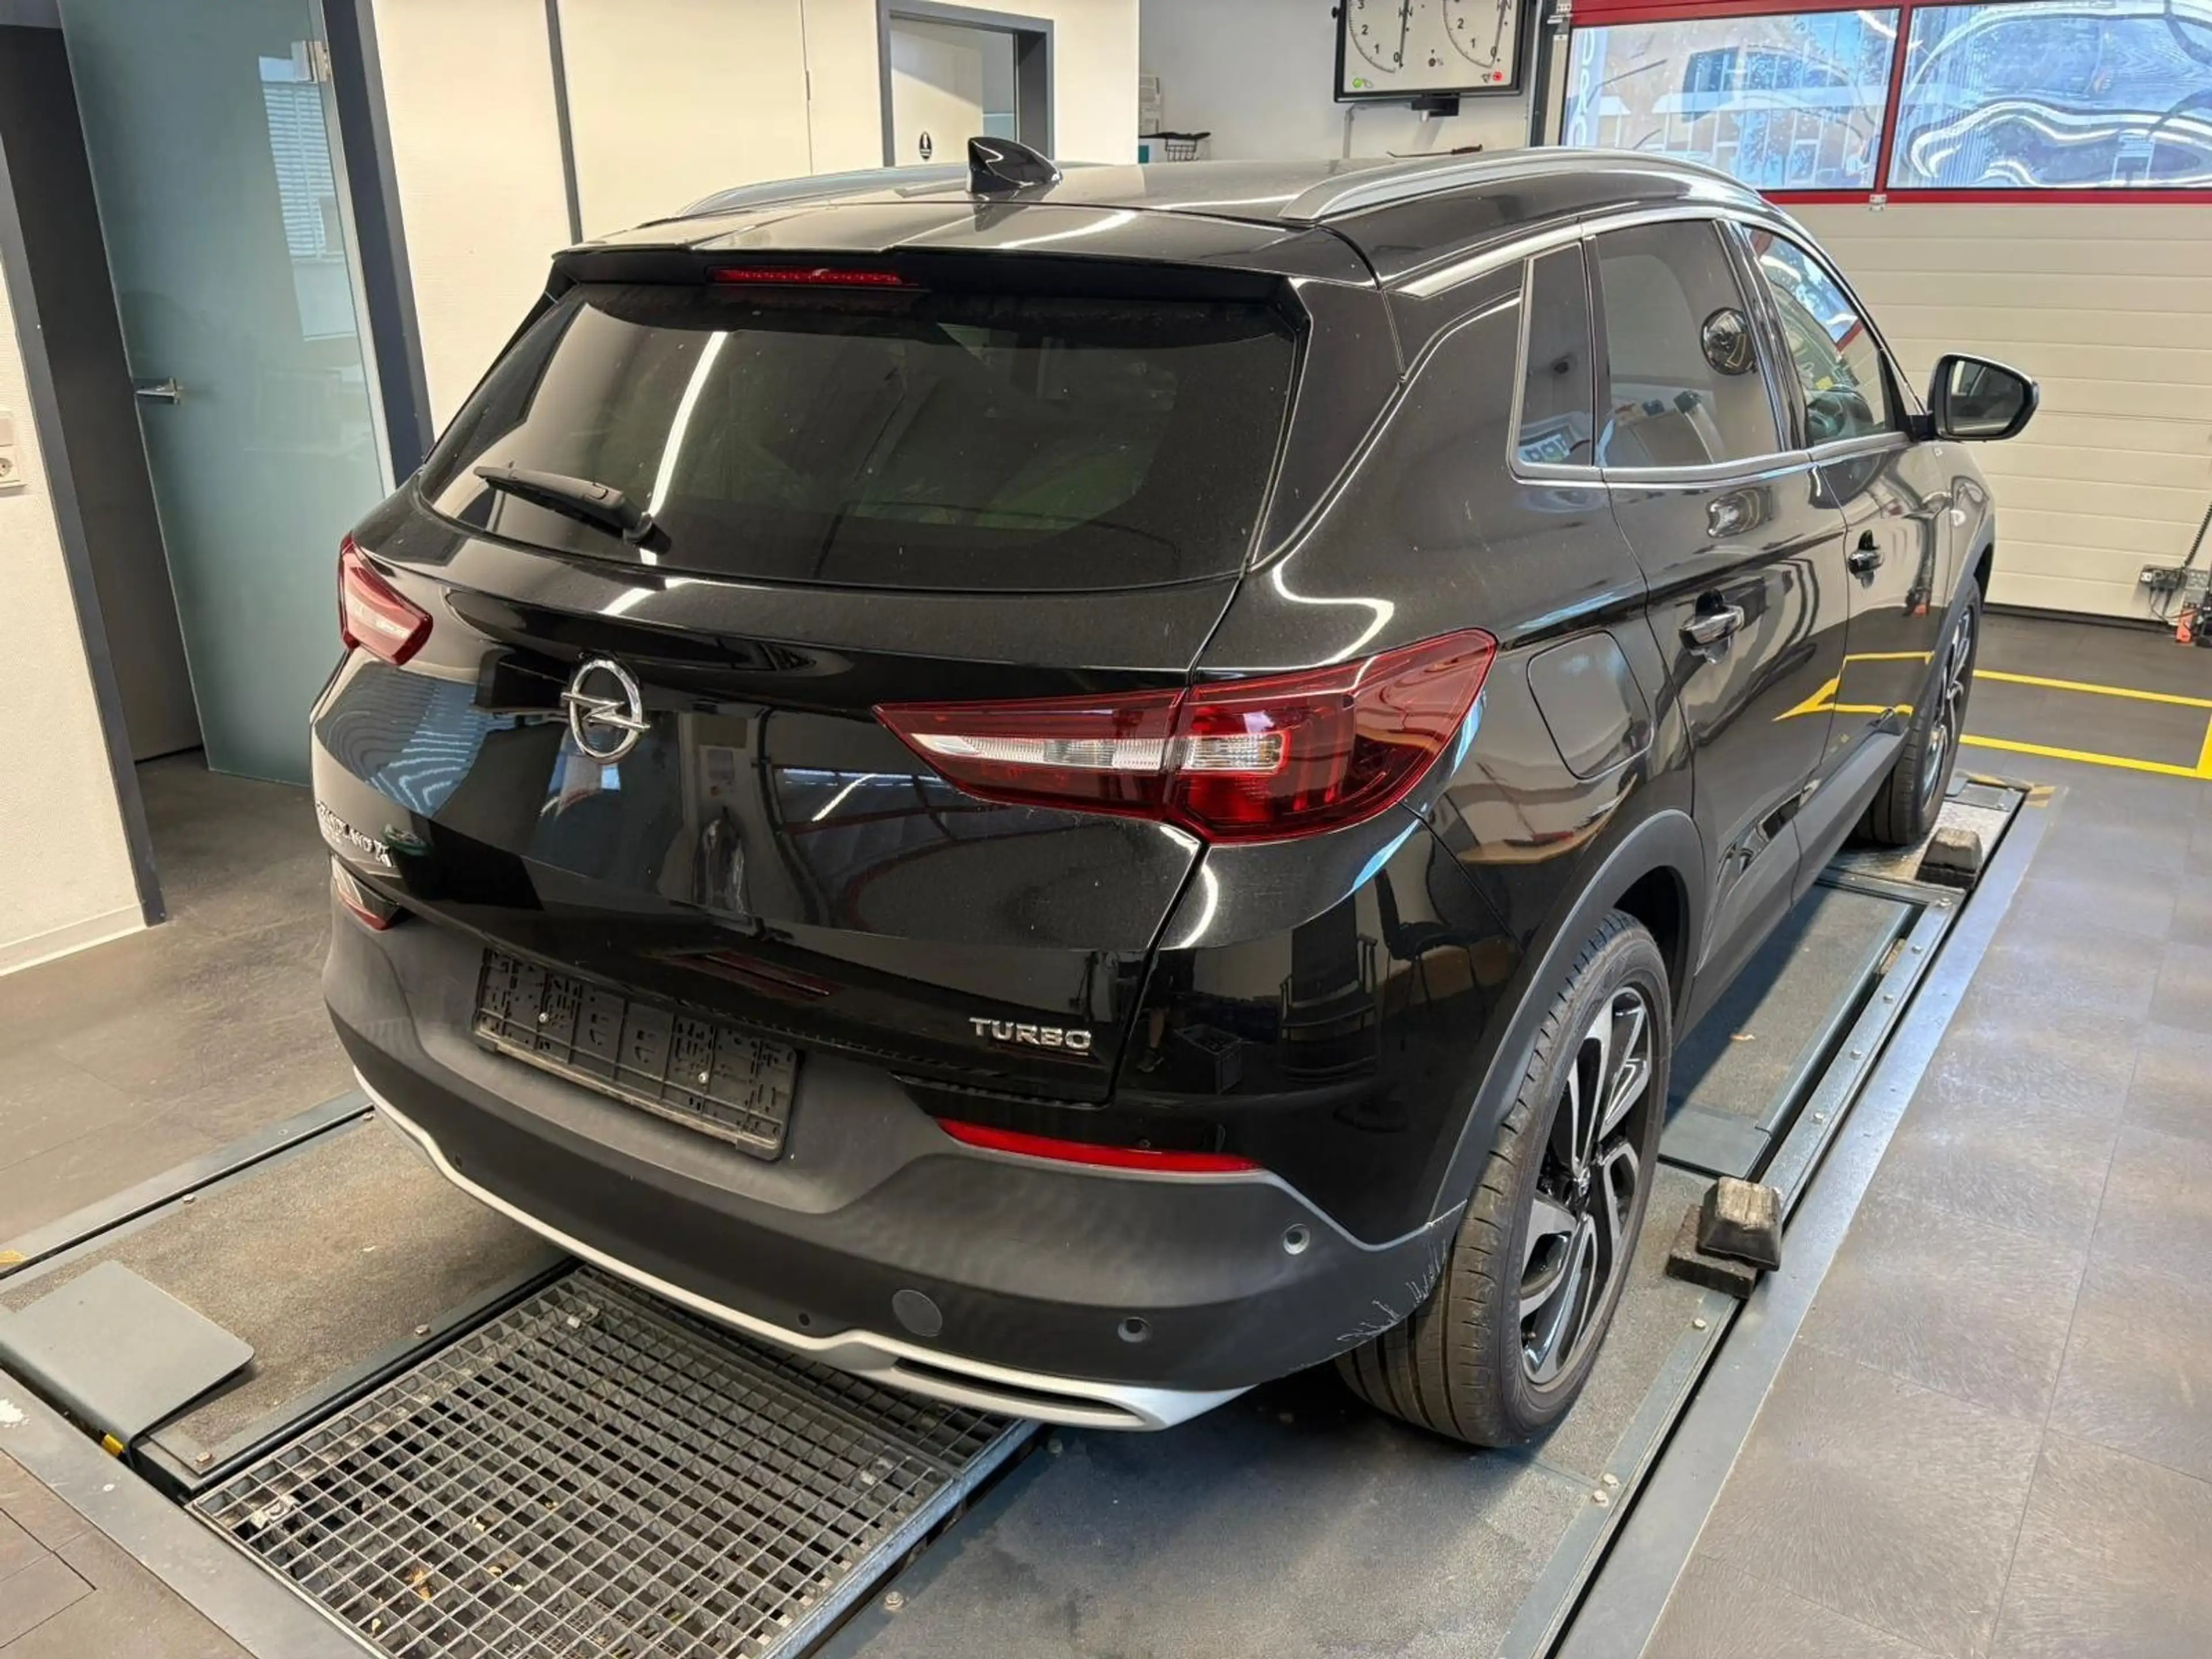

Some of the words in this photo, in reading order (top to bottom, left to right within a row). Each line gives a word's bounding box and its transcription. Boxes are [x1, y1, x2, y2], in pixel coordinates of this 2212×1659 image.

[1457, 17, 1464, 29] 2
[1362, 24, 1369, 35] 2
[1471, 37, 1476, 48] 1
[1374, 43, 1380, 54] 1
[969, 1017, 1092, 1050] TURBO
